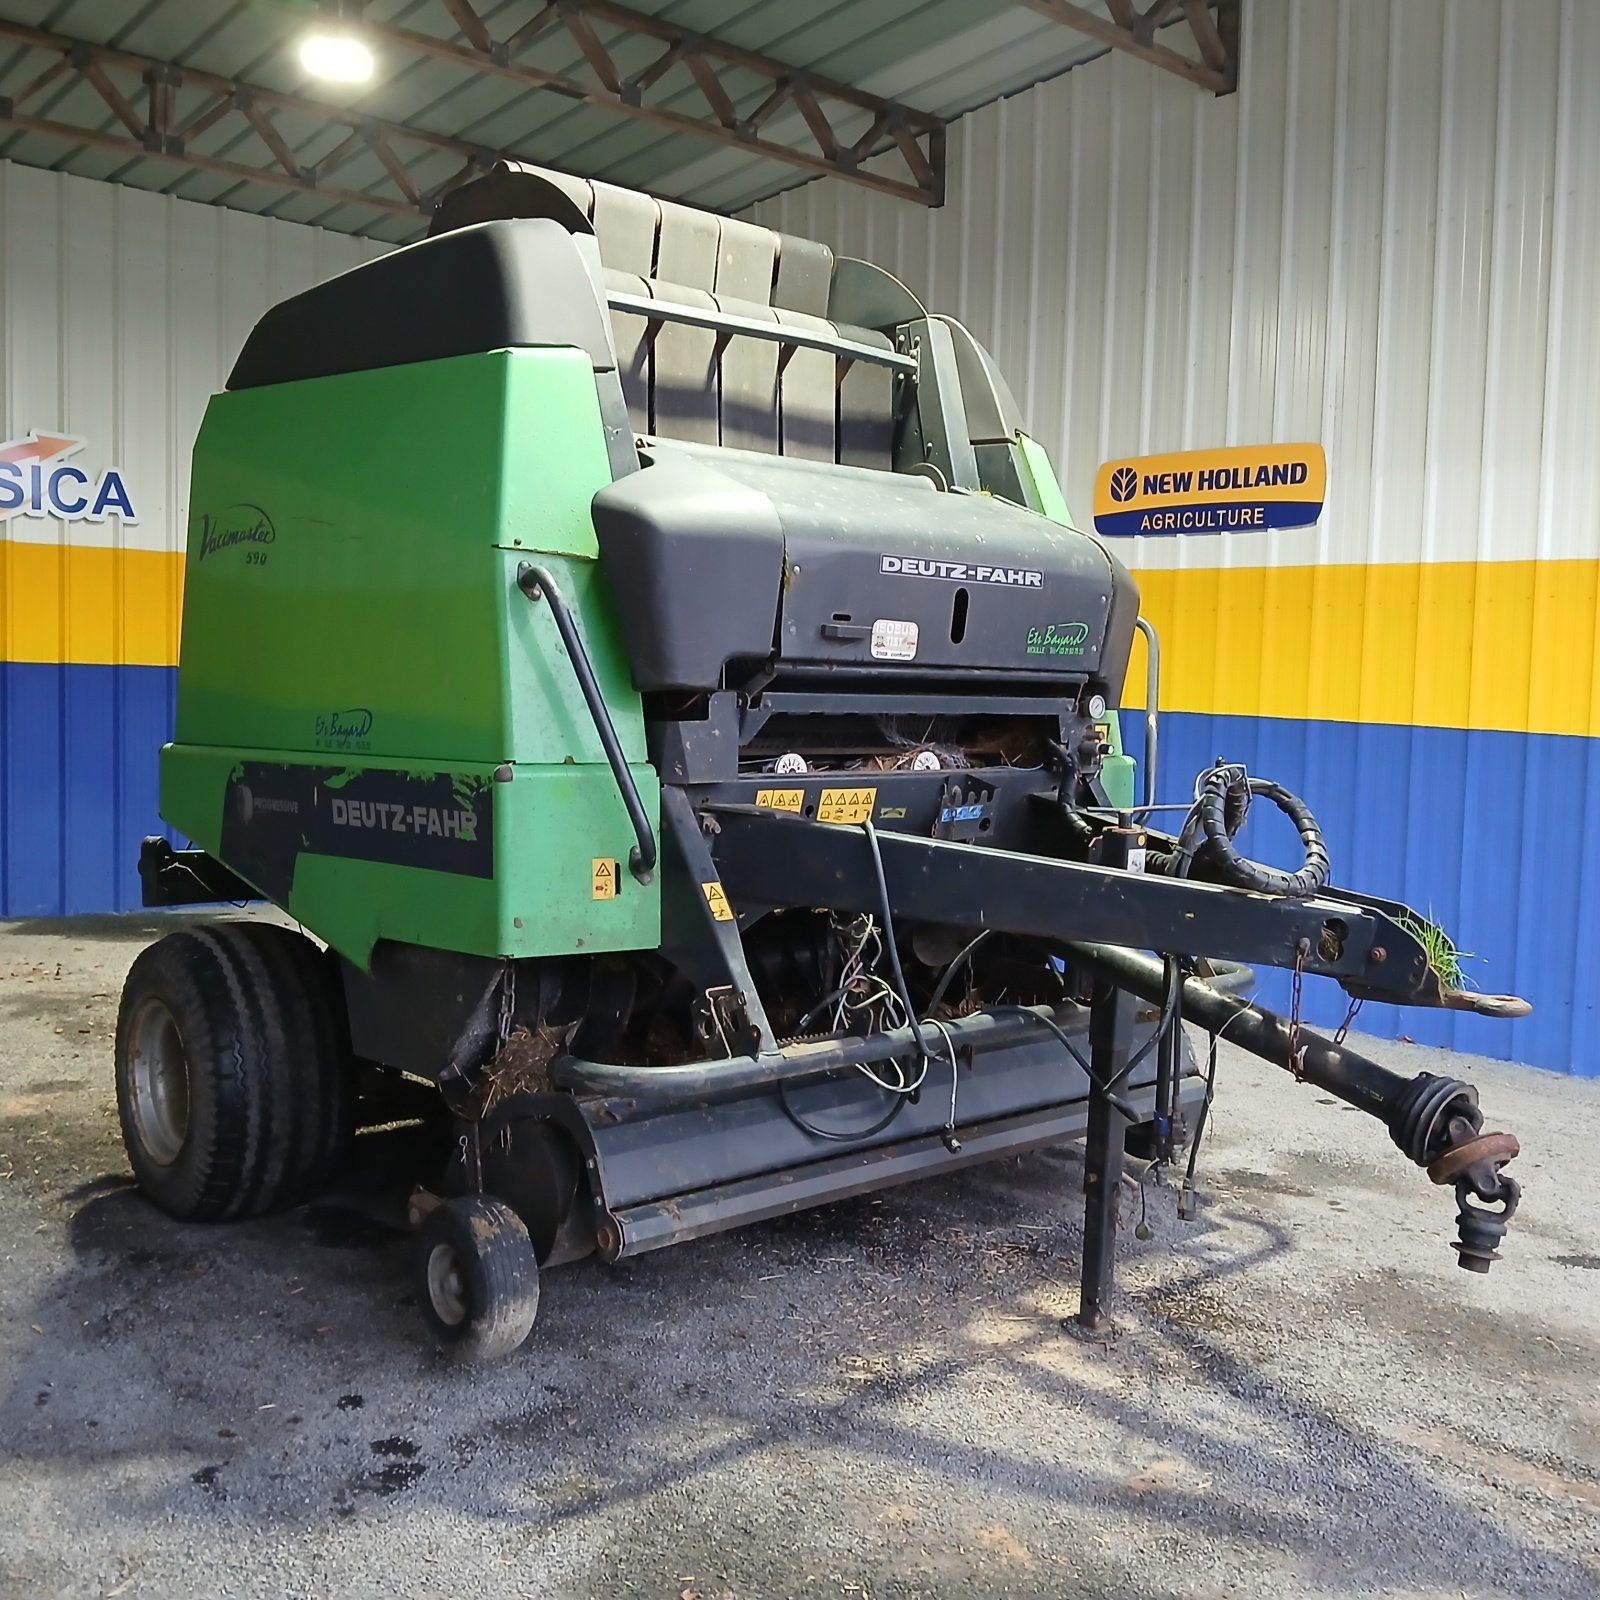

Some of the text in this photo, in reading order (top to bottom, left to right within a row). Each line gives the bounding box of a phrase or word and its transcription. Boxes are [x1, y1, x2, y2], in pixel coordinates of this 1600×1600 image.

[1142, 462, 1308, 495] NEW HOLLAND
[1140, 508, 1265, 530] AGRICULTURE
[245, 552, 268, 566] 590
[881, 555, 1043, 587] DEUTZ-FAHR
[876, 622, 916, 636] ISOBUS
[332, 799, 478, 841] DEUTZ-FAHR
